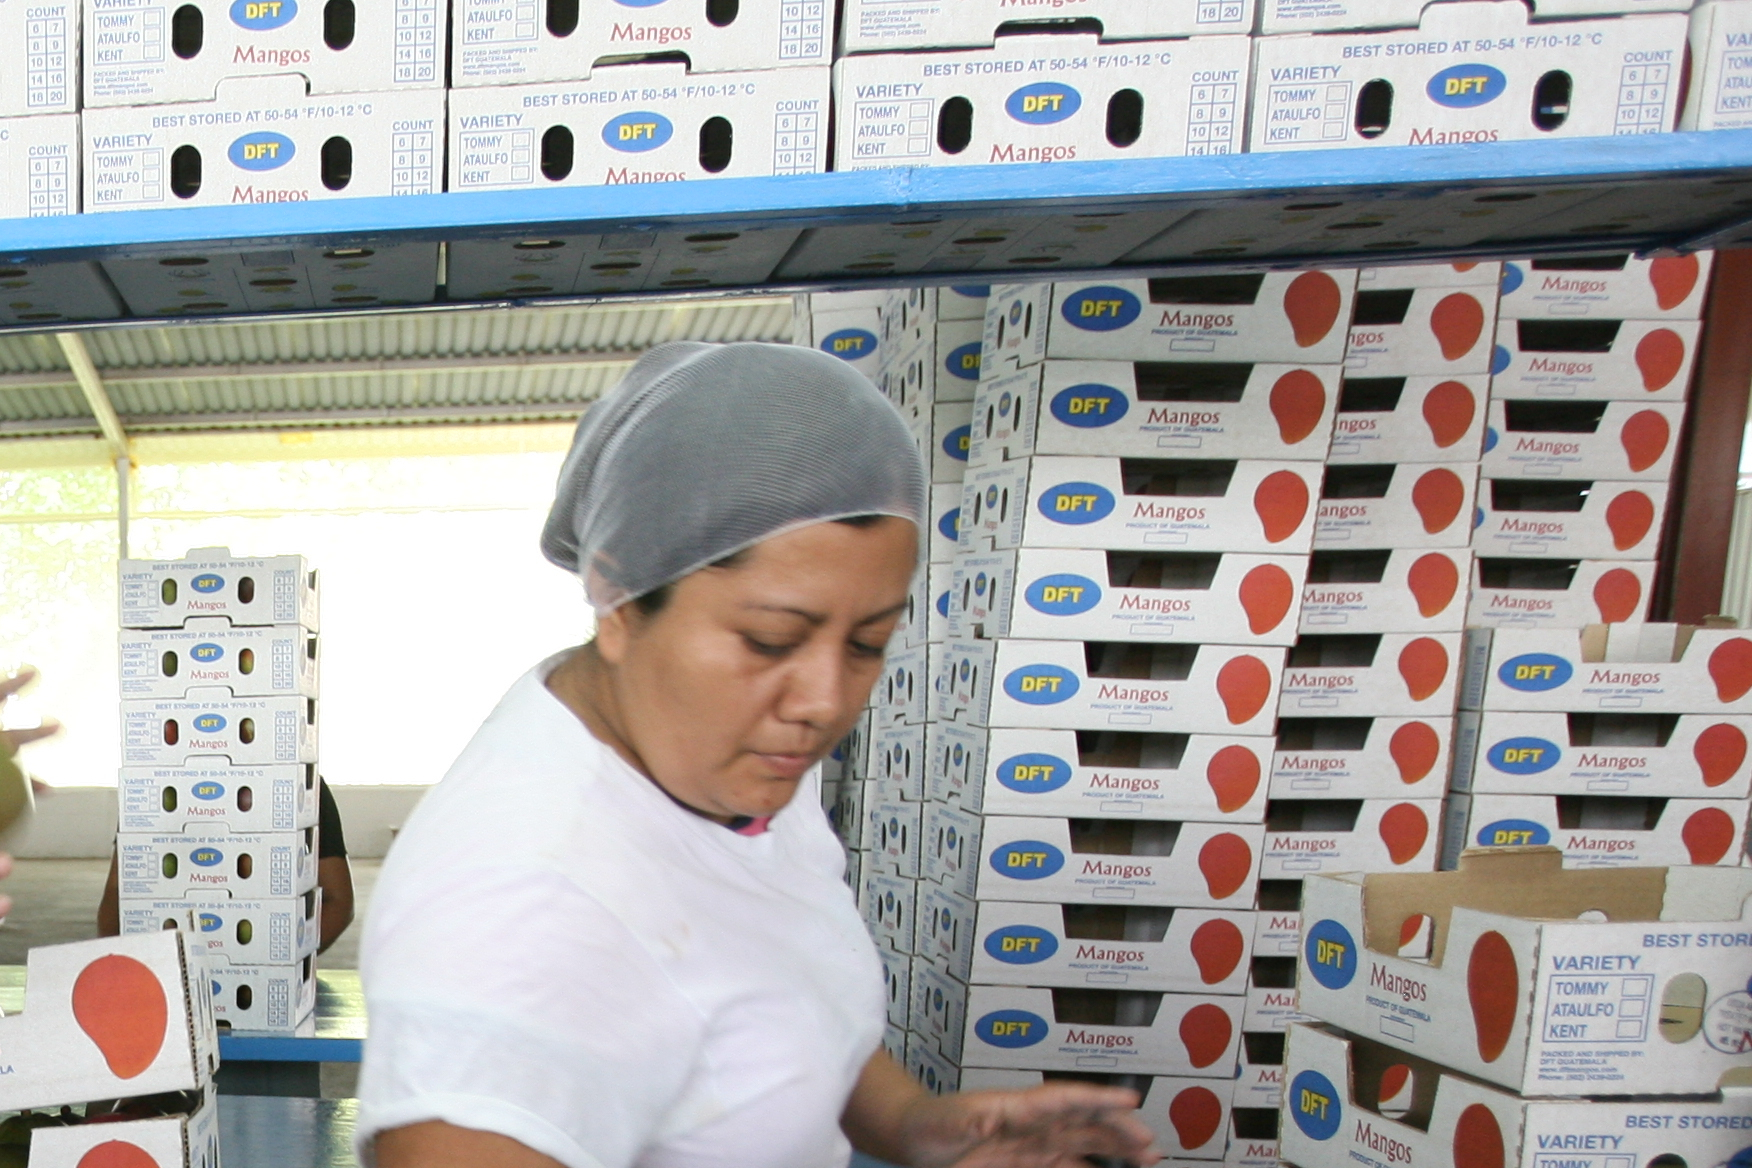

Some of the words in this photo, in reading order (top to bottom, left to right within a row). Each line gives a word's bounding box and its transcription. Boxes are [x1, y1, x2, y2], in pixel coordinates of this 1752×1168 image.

[246, 1, 283, 19] DFT
[610, 23, 692, 45] Mangos
[232, 46, 311, 67] Mangos
[1342, 44, 1383, 59] BEST
[1385, 41, 1449, 57] STORED
[1452, 40, 1471, 52] AT
[1623, 49, 1673, 64] COUNT
[1191, 69, 1240, 83] COUNT
[1271, 65, 1341, 81] VARIETY
[855, 83, 924, 98] VARIETY
[1445, 76, 1489, 96] DFT
[1023, 94, 1064, 113] DFT
[1273, 89, 1316, 103] TOMMY
[460, 113, 523, 129] VARIETY
[1271, 107, 1321, 121] ATAULFO
[619, 122, 658, 141] DFT
[1269, 126, 1301, 140] KENT
[244, 142, 280, 160] DFT
[989, 144, 1076, 163] Mangos
[231, 186, 309, 203] Mangos
[1542, 277, 1606, 295] Mangos
[1081, 300, 1123, 317] DFT
[1159, 311, 1233, 330] Mangos
[834, 337, 863, 351] DFT
[1528, 359, 1593, 376] Mangos
[1069, 397, 1111, 414] DFT
[1147, 409, 1219, 428] Mangos
[1515, 438, 1579, 456] Mangos
[1056, 494, 1098, 511] DFT
[1133, 502, 1206, 523] Mangos
[1499, 519, 1564, 535] Mangos
[1043, 586, 1083, 602] DFT
[1301, 589, 1363, 606] Mangos
[187, 600, 226, 611] Mangos
[1120, 595, 1190, 614] Mangos
[1490, 595, 1553, 612] Mangos
[191, 670, 229, 680] Mangos
[1515, 665, 1555, 680] DFT
[1590, 669, 1660, 687] Mangos
[1021, 675, 1062, 692] DFT
[1288, 673, 1354, 690] Mangos
[1097, 684, 1169, 705] Mangos
[189, 739, 228, 749] Mangos
[1280, 756, 1345, 772] Mangos
[1504, 748, 1544, 763] DFT
[1577, 754, 1646, 771] Mangos
[1014, 765, 1054, 780] DFT
[1090, 774, 1159, 793] Mangos
[187, 807, 226, 816] Mangos
[1272, 837, 1336, 853] Mangos
[1494, 830, 1533, 845] DFT
[1567, 836, 1634, 853] Mangos
[1007, 851, 1047, 867] DFT
[1081, 860, 1151, 880] Mangos
[190, 874, 228, 884] Mangos
[1001, 936, 1041, 952] DFT
[1642, 934, 1693, 948] BEST
[1696, 933, 1752, 948] STOR
[1076, 945, 1144, 964] Mangos
[1317, 939, 1346, 967] DFT
[1552, 955, 1640, 971] VARIETY
[1370, 964, 1427, 1003] Mangos
[1556, 981, 1609, 996] TOMMY
[1552, 1002, 1614, 1017] ATAULFO
[992, 1021, 1031, 1036] DFT
[1550, 1024, 1588, 1039] KENT
[1064, 1030, 1134, 1048] Mangos
[1300, 1089, 1330, 1119] DFT
[1625, 1115, 1674, 1129] BEST
[1355, 1119, 1412, 1163] Mangos
[1538, 1134, 1624, 1150] VARIETY
